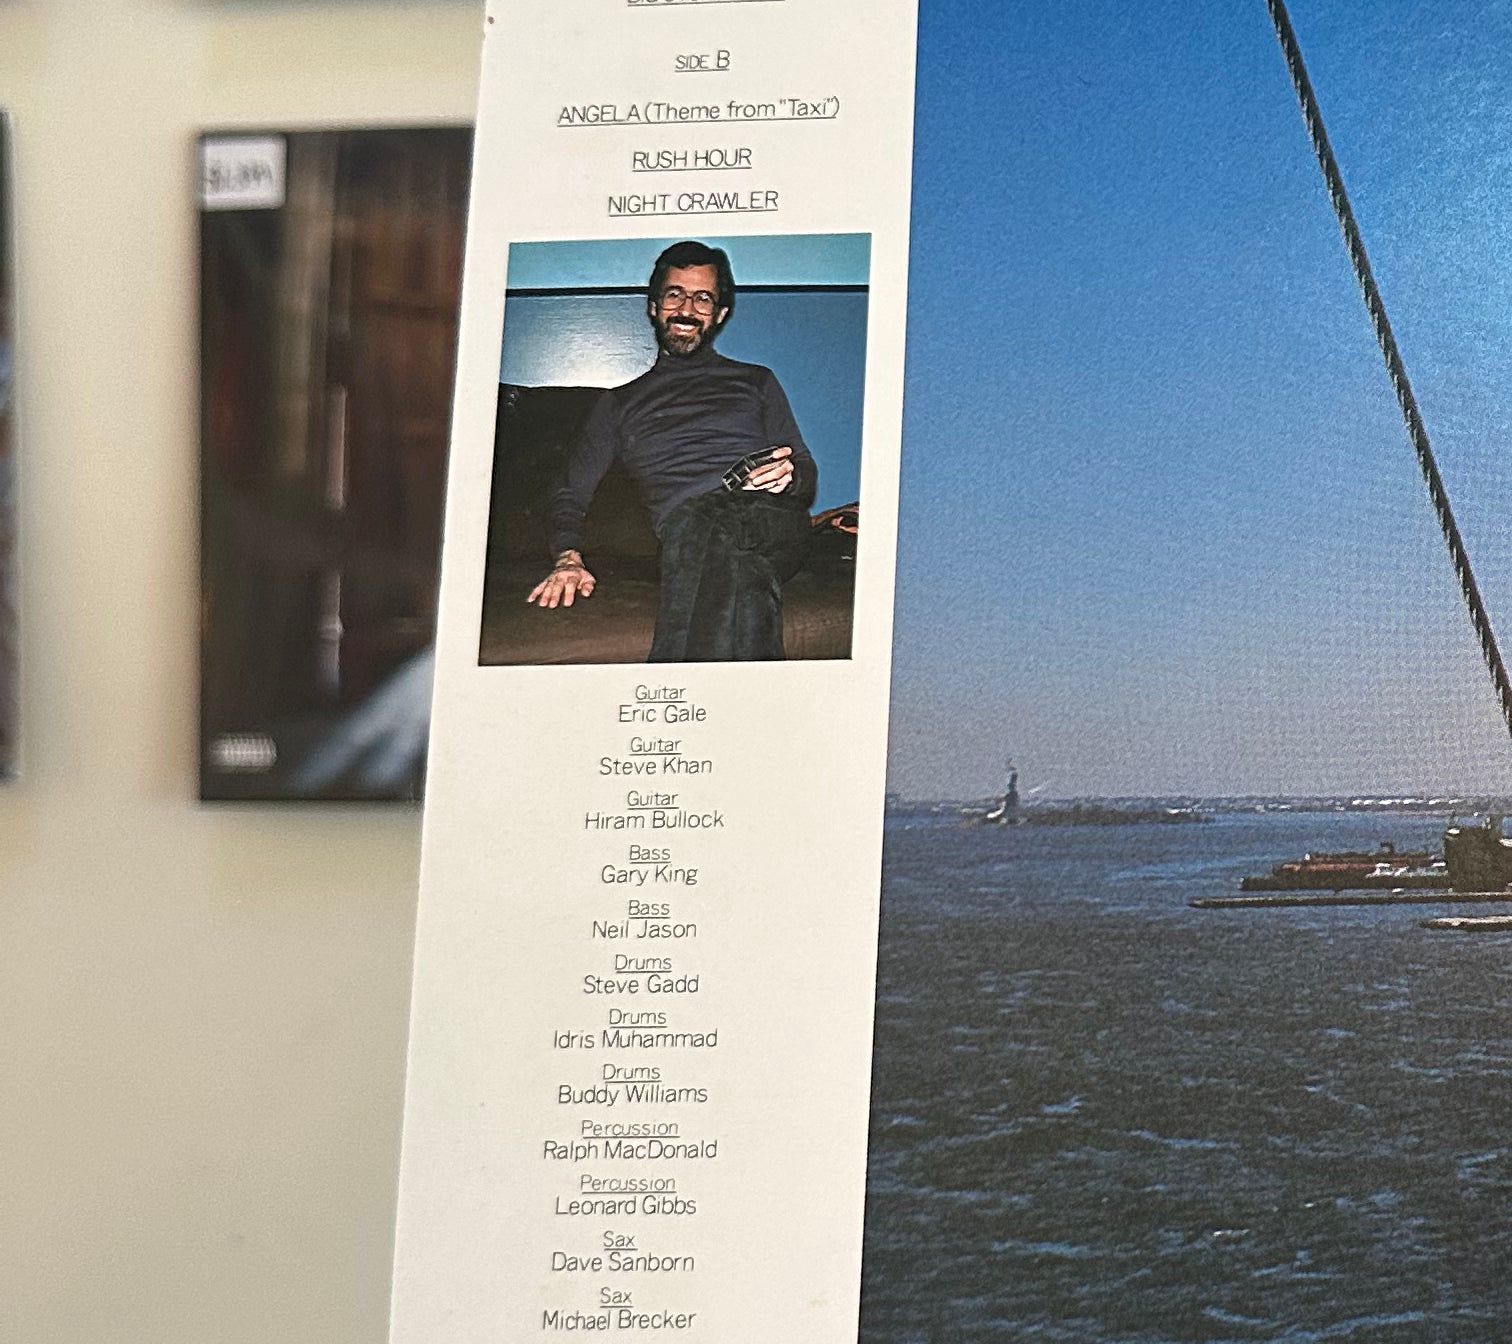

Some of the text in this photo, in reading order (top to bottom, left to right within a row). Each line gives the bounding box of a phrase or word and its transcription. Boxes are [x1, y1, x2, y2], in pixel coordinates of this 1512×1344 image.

[674, 49, 731, 71] SIDE B
[557, 104, 641, 125] ANGELA
[726, 99, 777, 119] from
[631, 147, 753, 170] RUSH HOUR
[607, 190, 779, 215] NIGHT CRAWLER
[634, 683, 687, 702] Guitar
[618, 704, 708, 724] Eric Gale
[629, 736, 682, 754] Guitar
[599, 756, 713, 776] Steve Khan
[626, 790, 679, 807] Guitar
[584, 809, 726, 830] Hiram Bullock
[628, 844, 672, 862] Bass
[601, 864, 699, 887] Gary King
[628, 899, 671, 917] Bass
[592, 920, 698, 940] Neil Jason
[614, 953, 673, 971] Drums
[583, 973, 700, 995] Steve Gadd
[608, 1008, 668, 1026] Drums
[553, 1028, 719, 1049] Idris Muhammad
[602, 1063, 661, 1081] Drums
[557, 1083, 709, 1108] Buddy Williams
[580, 1119, 679, 1137] Percussion
[543, 1139, 718, 1163] Ralph MacDonald
[580, 1173, 677, 1192] Percussion
[555, 1194, 697, 1216] Leonard Gibbs
[602, 1230, 636, 1248] Sax
[551, 1251, 696, 1273] Dave Sanborn
[599, 1286, 633, 1305] Sax
[542, 1309, 697, 1331] Michael Brecker
